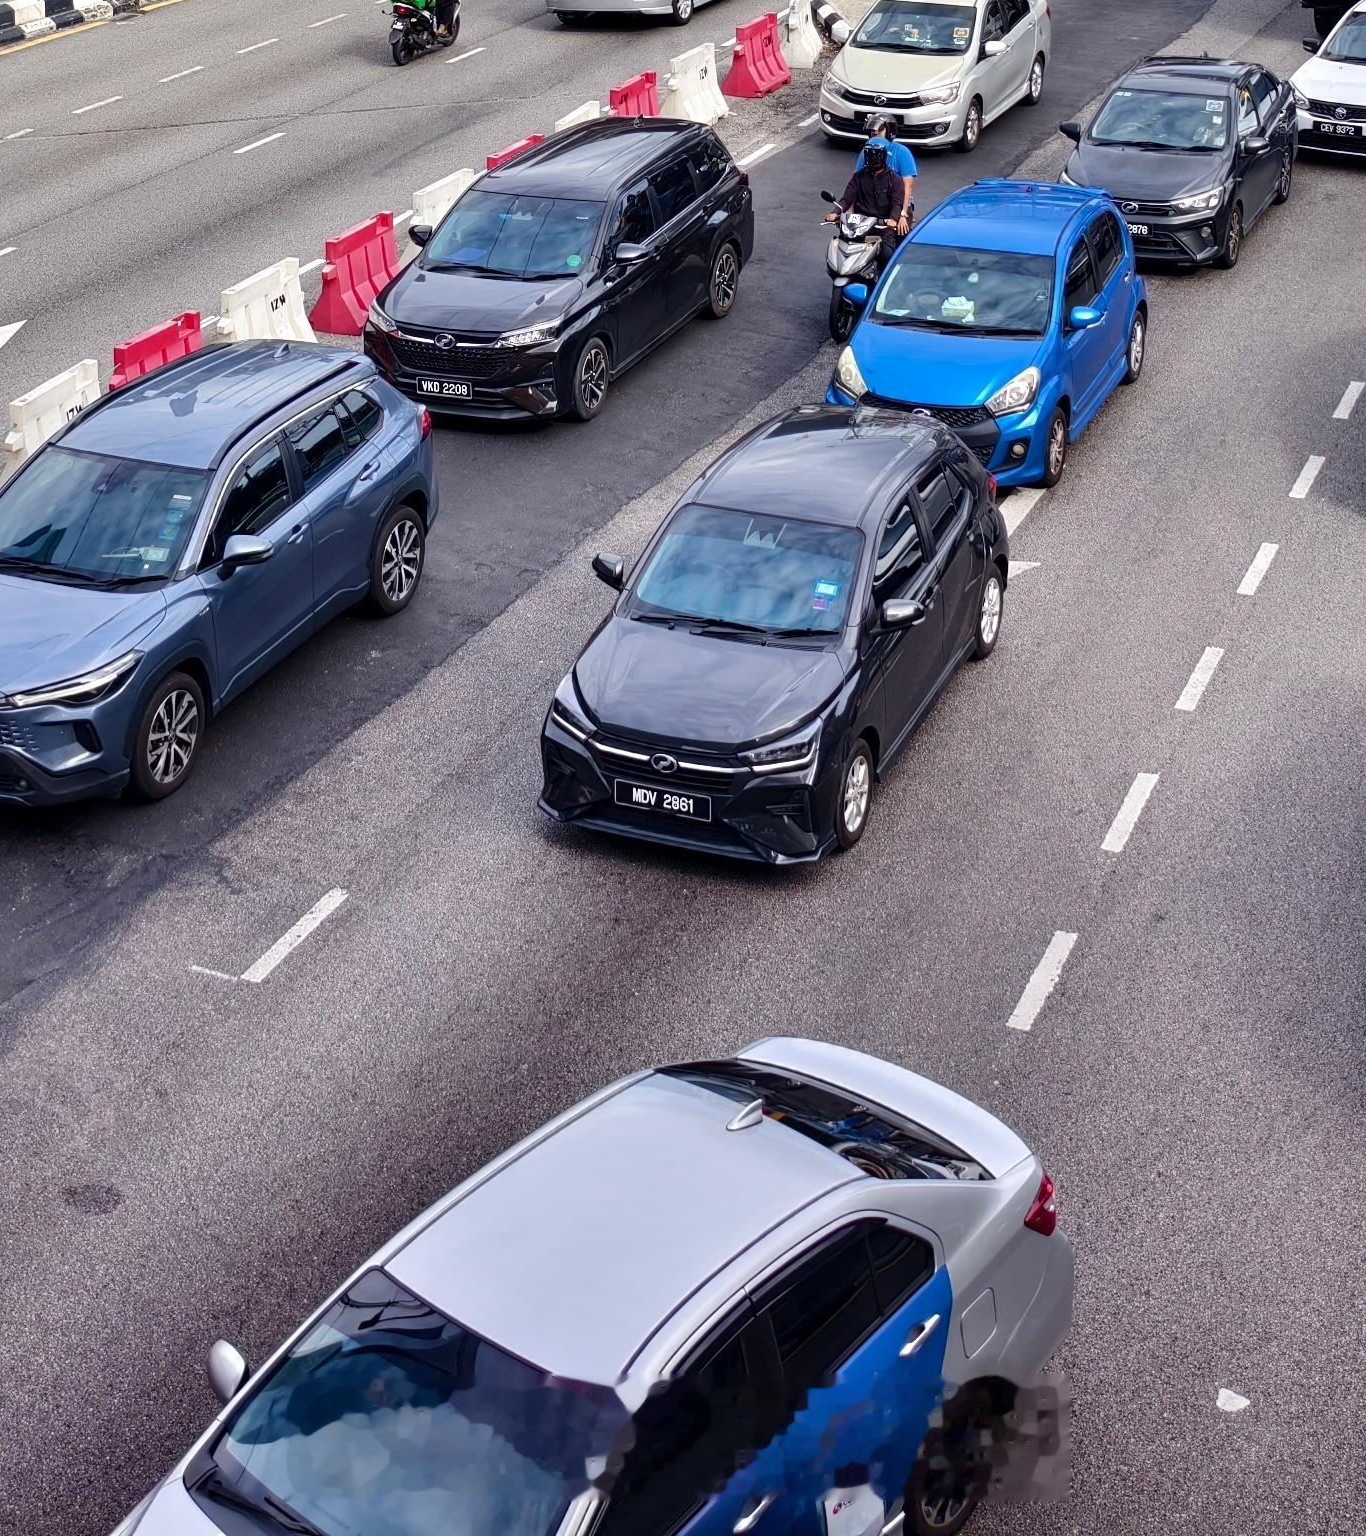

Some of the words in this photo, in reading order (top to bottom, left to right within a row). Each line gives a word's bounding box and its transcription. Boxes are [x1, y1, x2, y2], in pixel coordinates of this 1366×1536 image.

[1320, 124, 1335, 133] CEV
[1336, 125, 1355, 135] 9372
[421, 380, 440, 393] VKD
[442, 383, 468, 395] 2208
[632, 787, 657, 806] MDV
[663, 794, 694, 814] 2861
